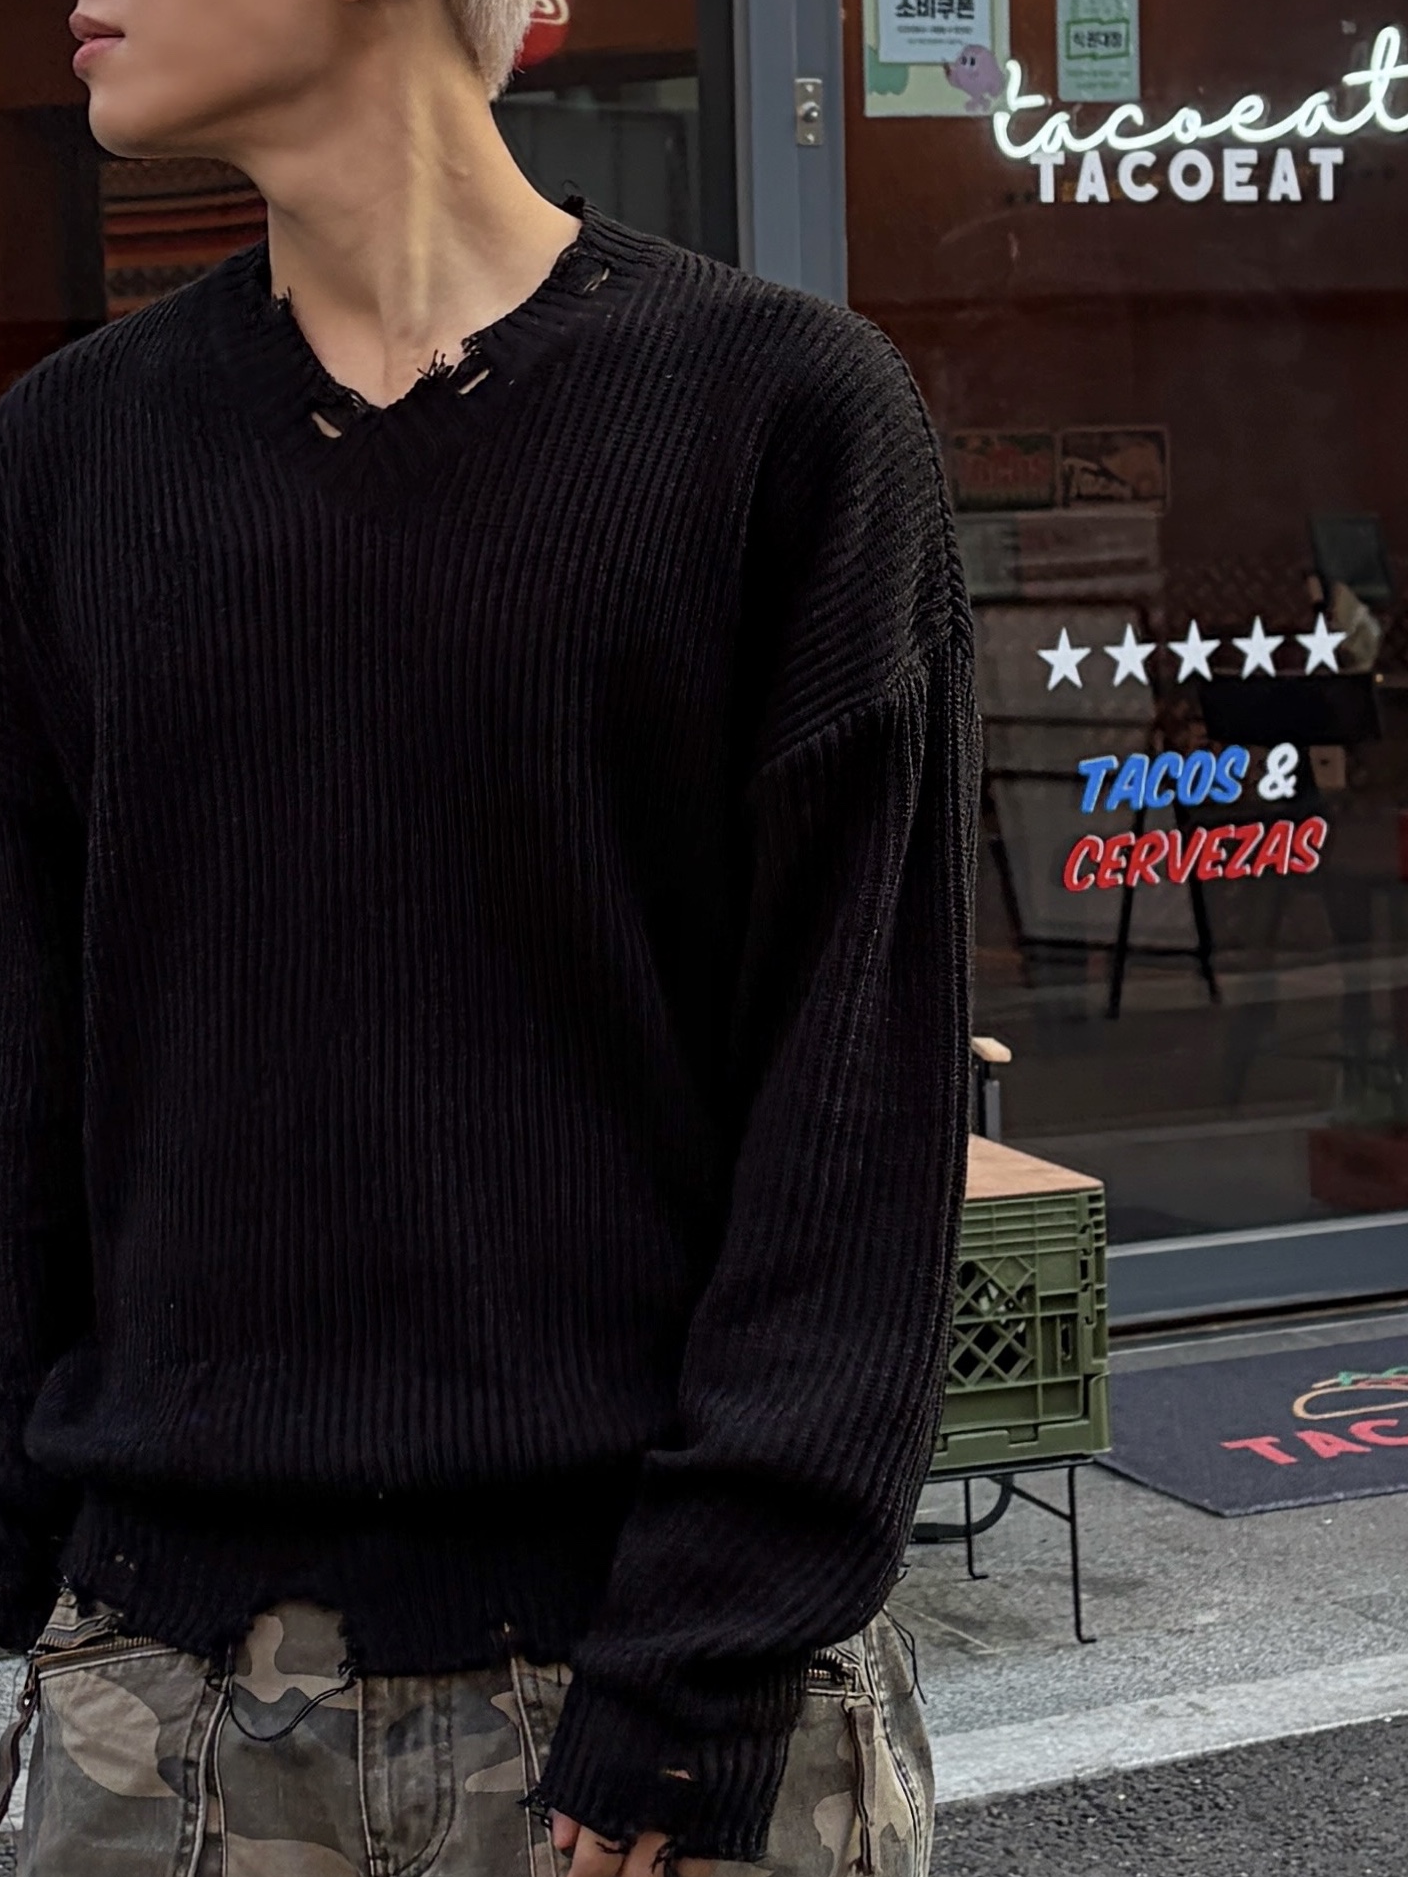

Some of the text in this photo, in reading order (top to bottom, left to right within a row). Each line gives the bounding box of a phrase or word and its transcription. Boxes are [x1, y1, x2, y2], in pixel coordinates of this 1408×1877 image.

[1028, 146, 1345, 205] TACOEAT
[1077, 741, 1300, 814] TACOS &
[1062, 815, 1328, 893] CERVEZAS
